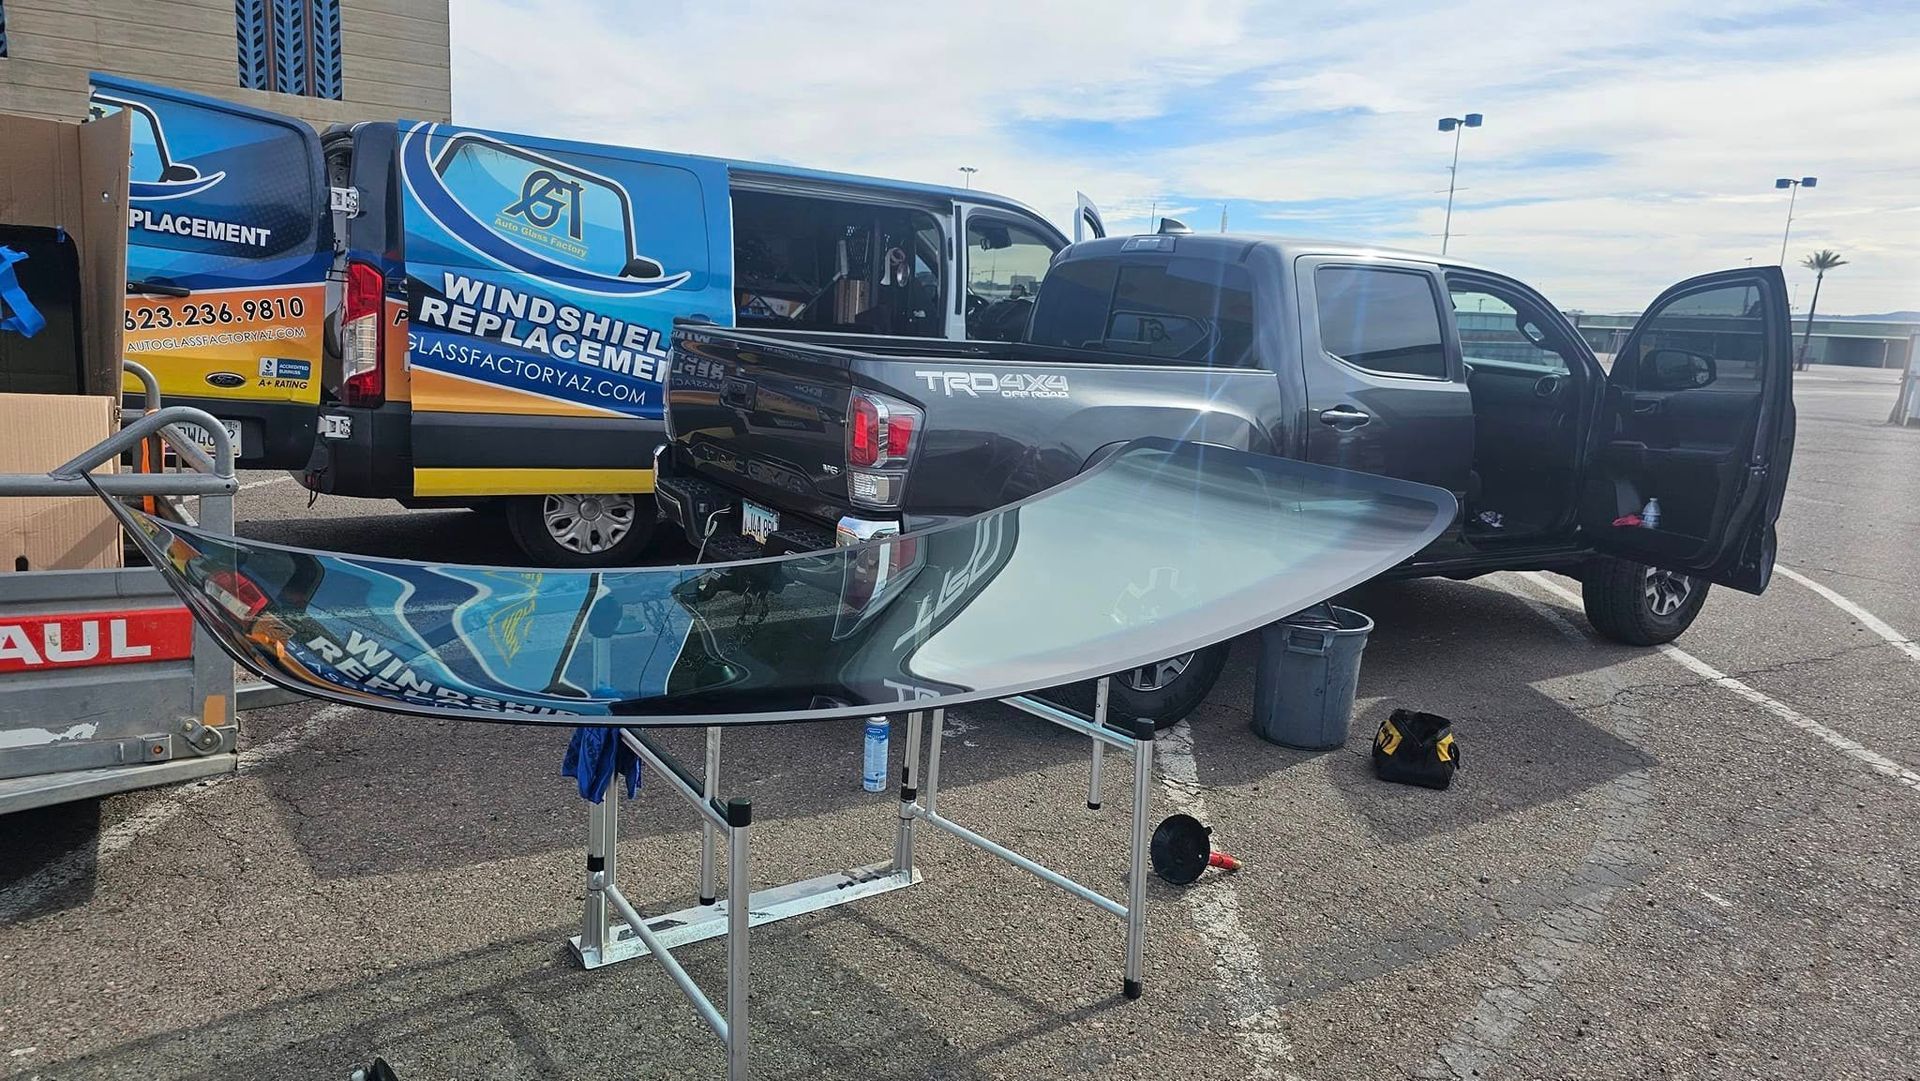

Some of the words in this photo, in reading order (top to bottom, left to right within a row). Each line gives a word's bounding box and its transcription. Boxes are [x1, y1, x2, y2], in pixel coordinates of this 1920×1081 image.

[130, 209, 271, 247] PLACEMENT
[495, 218, 518, 232] Auto
[521, 227, 548, 242] Glass
[550, 237, 588, 258] Factory
[125, 297, 305, 332] 623.236.9810
[127, 327, 306, 353] AUTOGLASSFACTORYAZ.COM
[258, 379, 272, 387] A+
[275, 380, 308, 389] RATING
[0, 619, 152, 665] AUL
